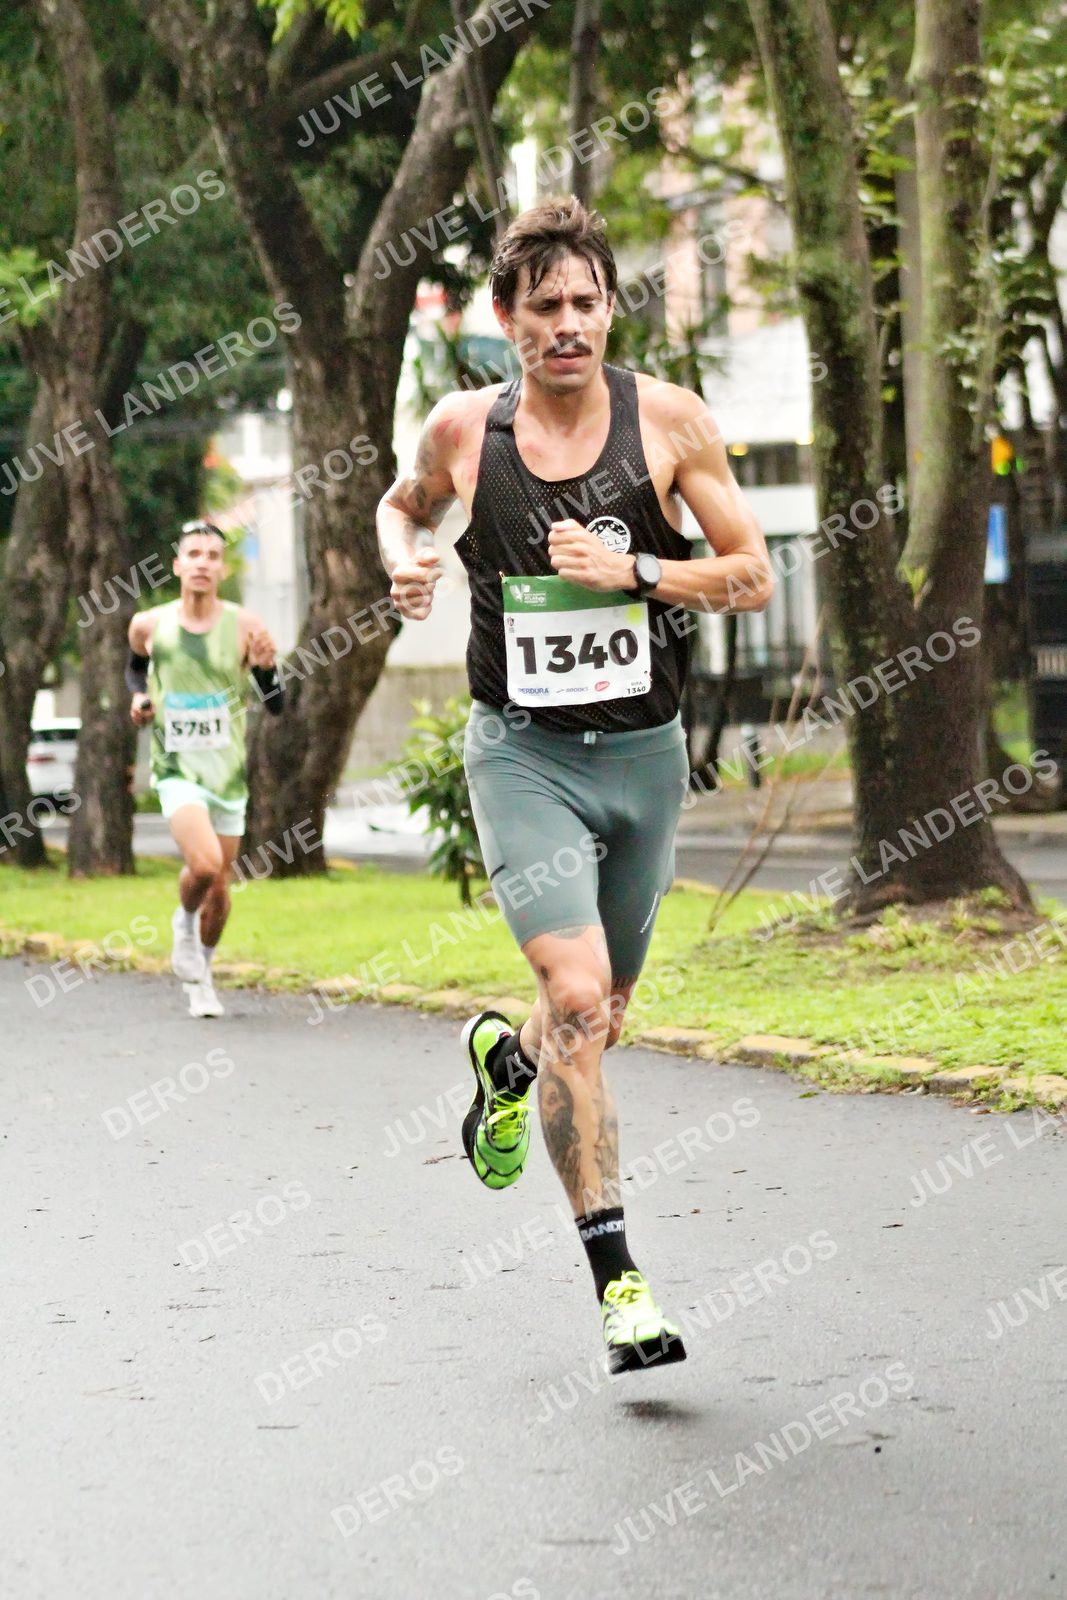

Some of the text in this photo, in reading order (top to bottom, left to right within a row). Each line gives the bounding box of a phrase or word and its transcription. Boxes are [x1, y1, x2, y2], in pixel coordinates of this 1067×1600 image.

[516, 628, 639, 675] 1340
[517, 687, 549, 695] PERDURA
[627, 686, 646, 695] 1340
[171, 718, 221, 737] 5781
